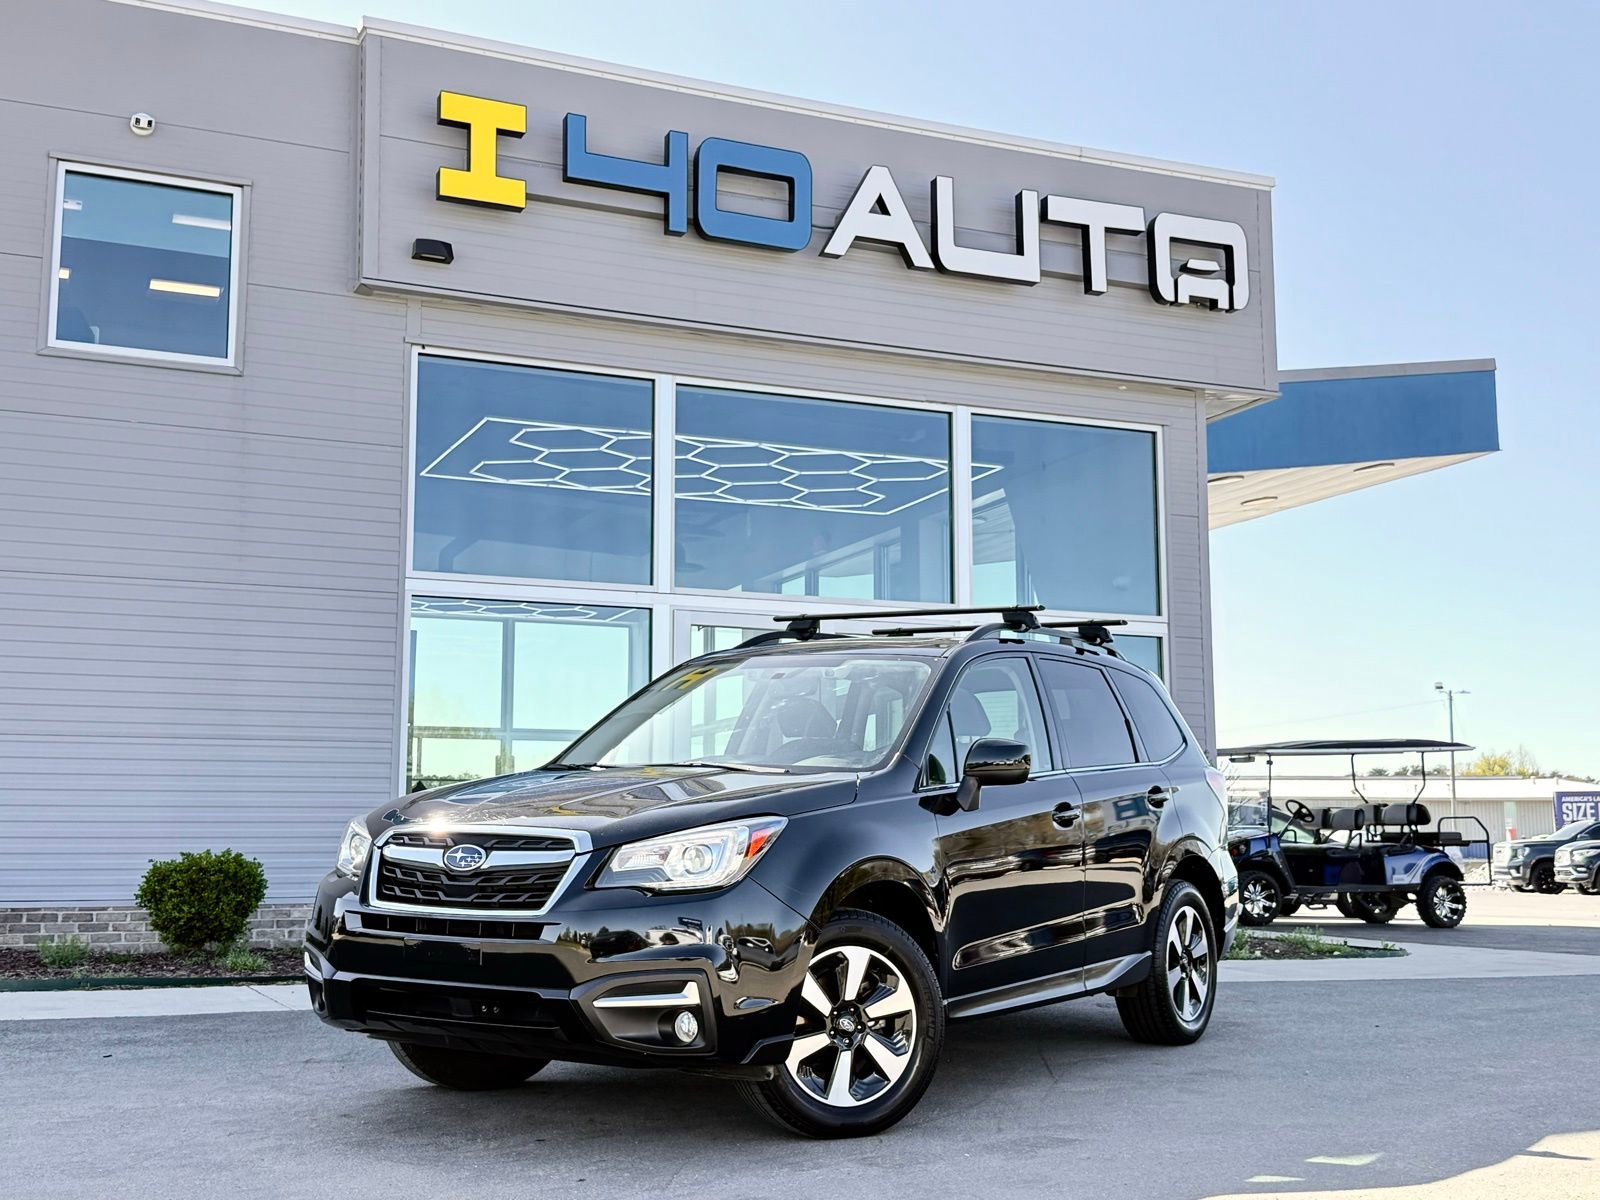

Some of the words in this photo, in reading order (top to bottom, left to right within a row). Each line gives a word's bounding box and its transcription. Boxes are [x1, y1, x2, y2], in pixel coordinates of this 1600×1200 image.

[437, 91, 527, 213] I
[562, 112, 813, 253] 40
[1561, 802, 1596, 821] SIZE
